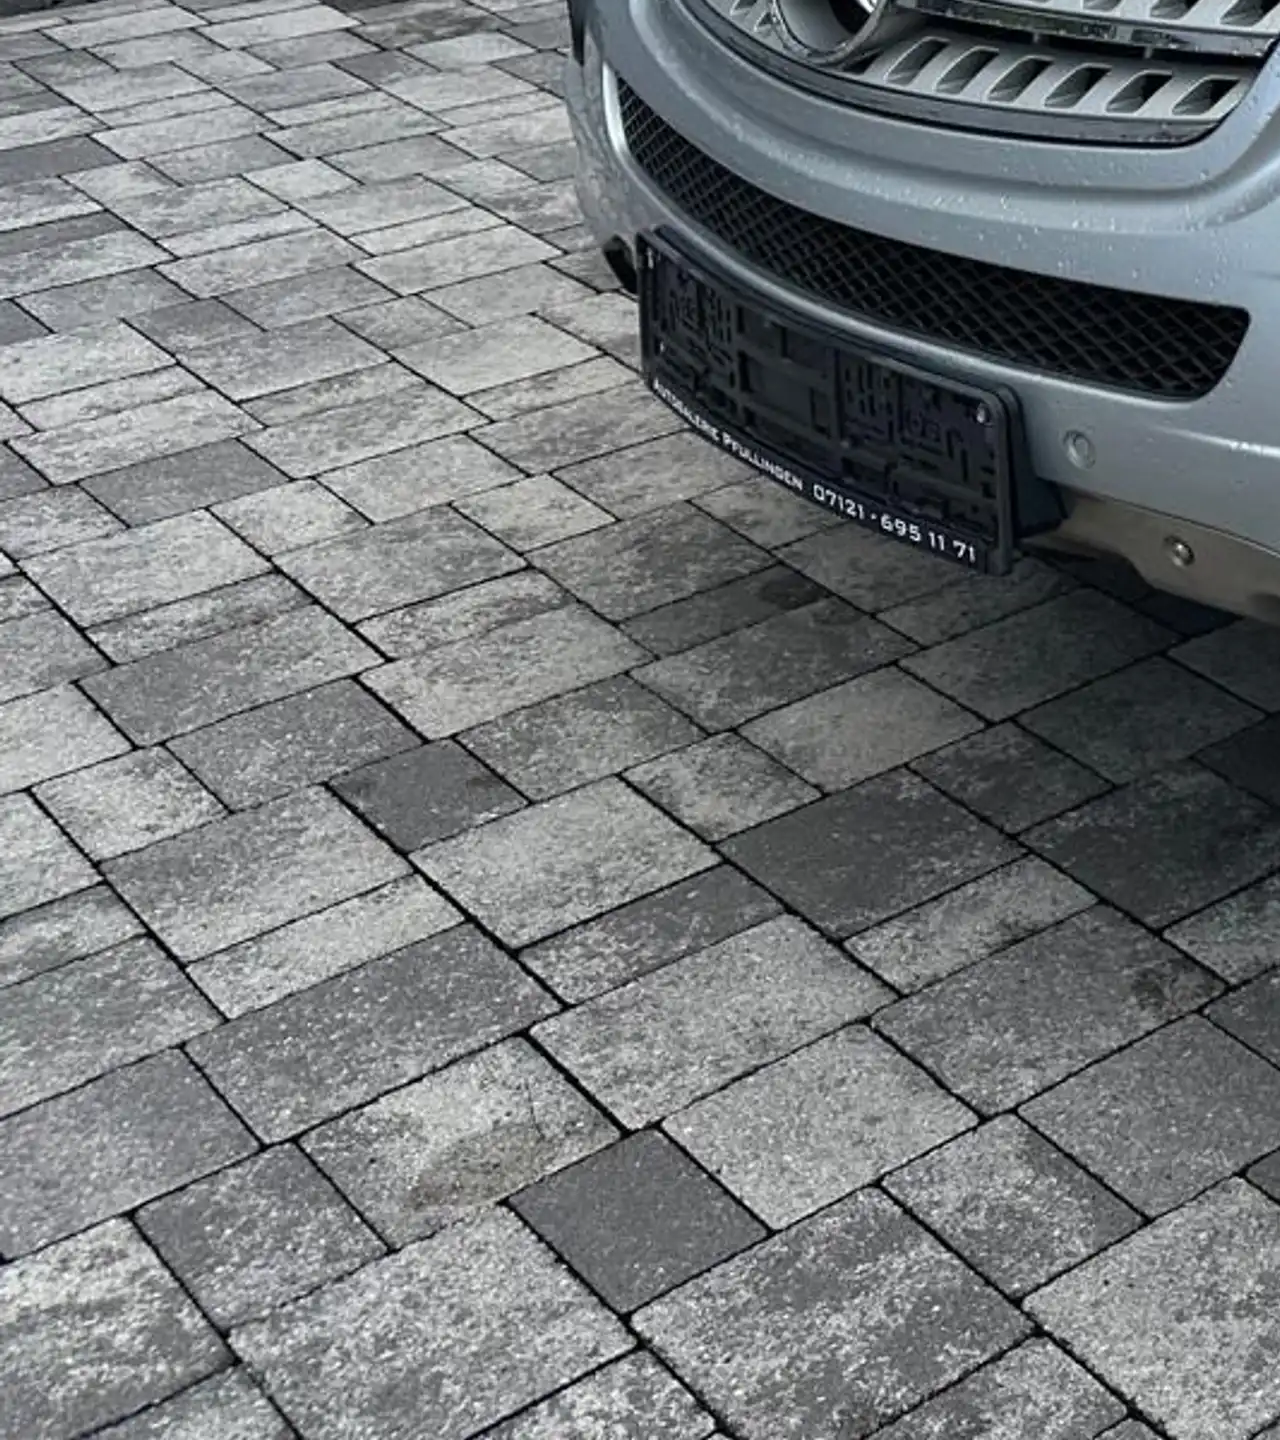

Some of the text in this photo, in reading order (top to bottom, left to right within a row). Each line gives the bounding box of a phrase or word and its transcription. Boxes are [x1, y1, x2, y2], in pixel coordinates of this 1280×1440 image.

[812, 483, 866, 520] 07121
[880, 513, 922, 542] 695
[928, 530, 945, 552] 11
[952, 539, 976, 563] 71
